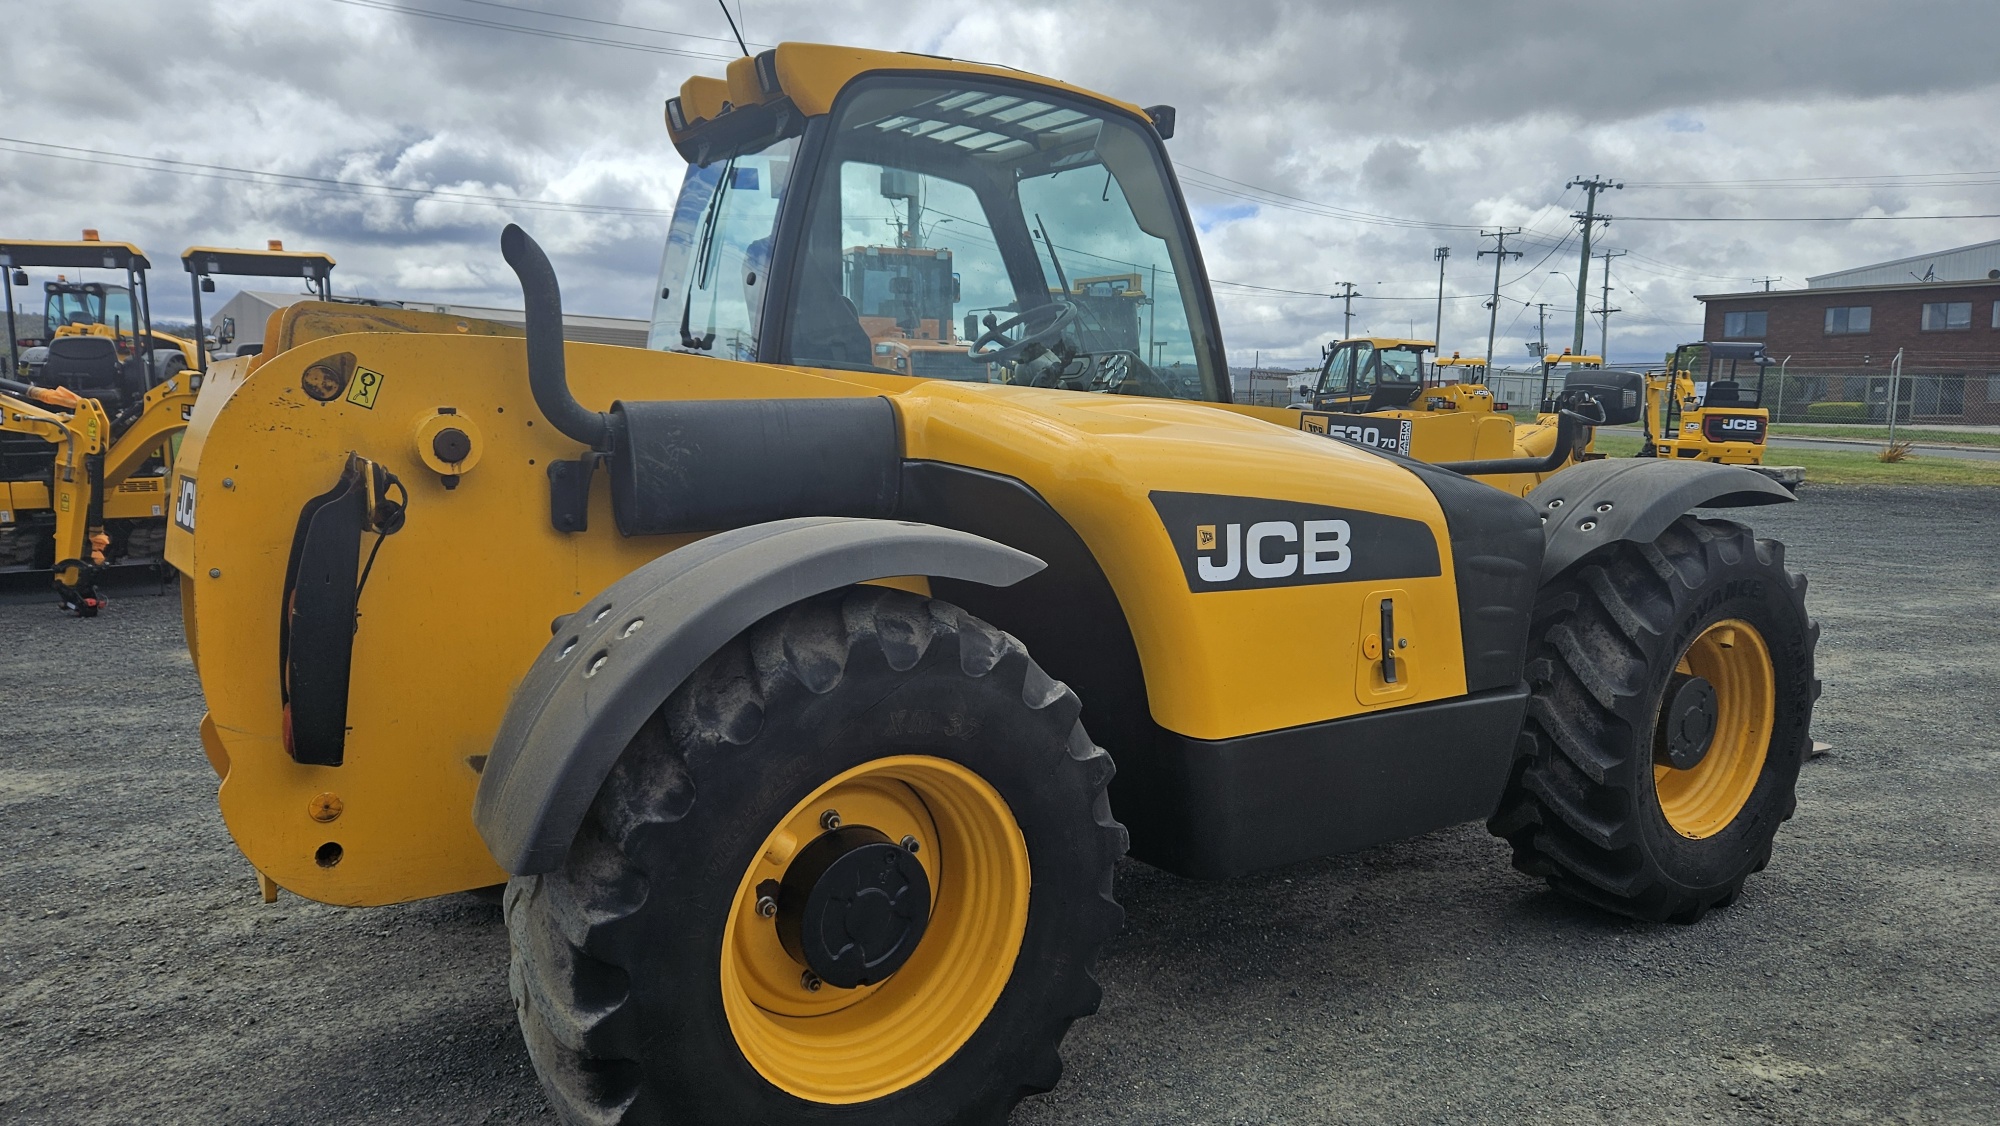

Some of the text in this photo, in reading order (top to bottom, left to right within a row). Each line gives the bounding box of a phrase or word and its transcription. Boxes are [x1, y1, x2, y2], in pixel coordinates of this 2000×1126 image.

[1685, 422, 1700, 430] JCB
[1722, 419, 1758, 430] JCB
[1381, 438, 1397, 449] 70
[1197, 519, 1352, 582] JCB
